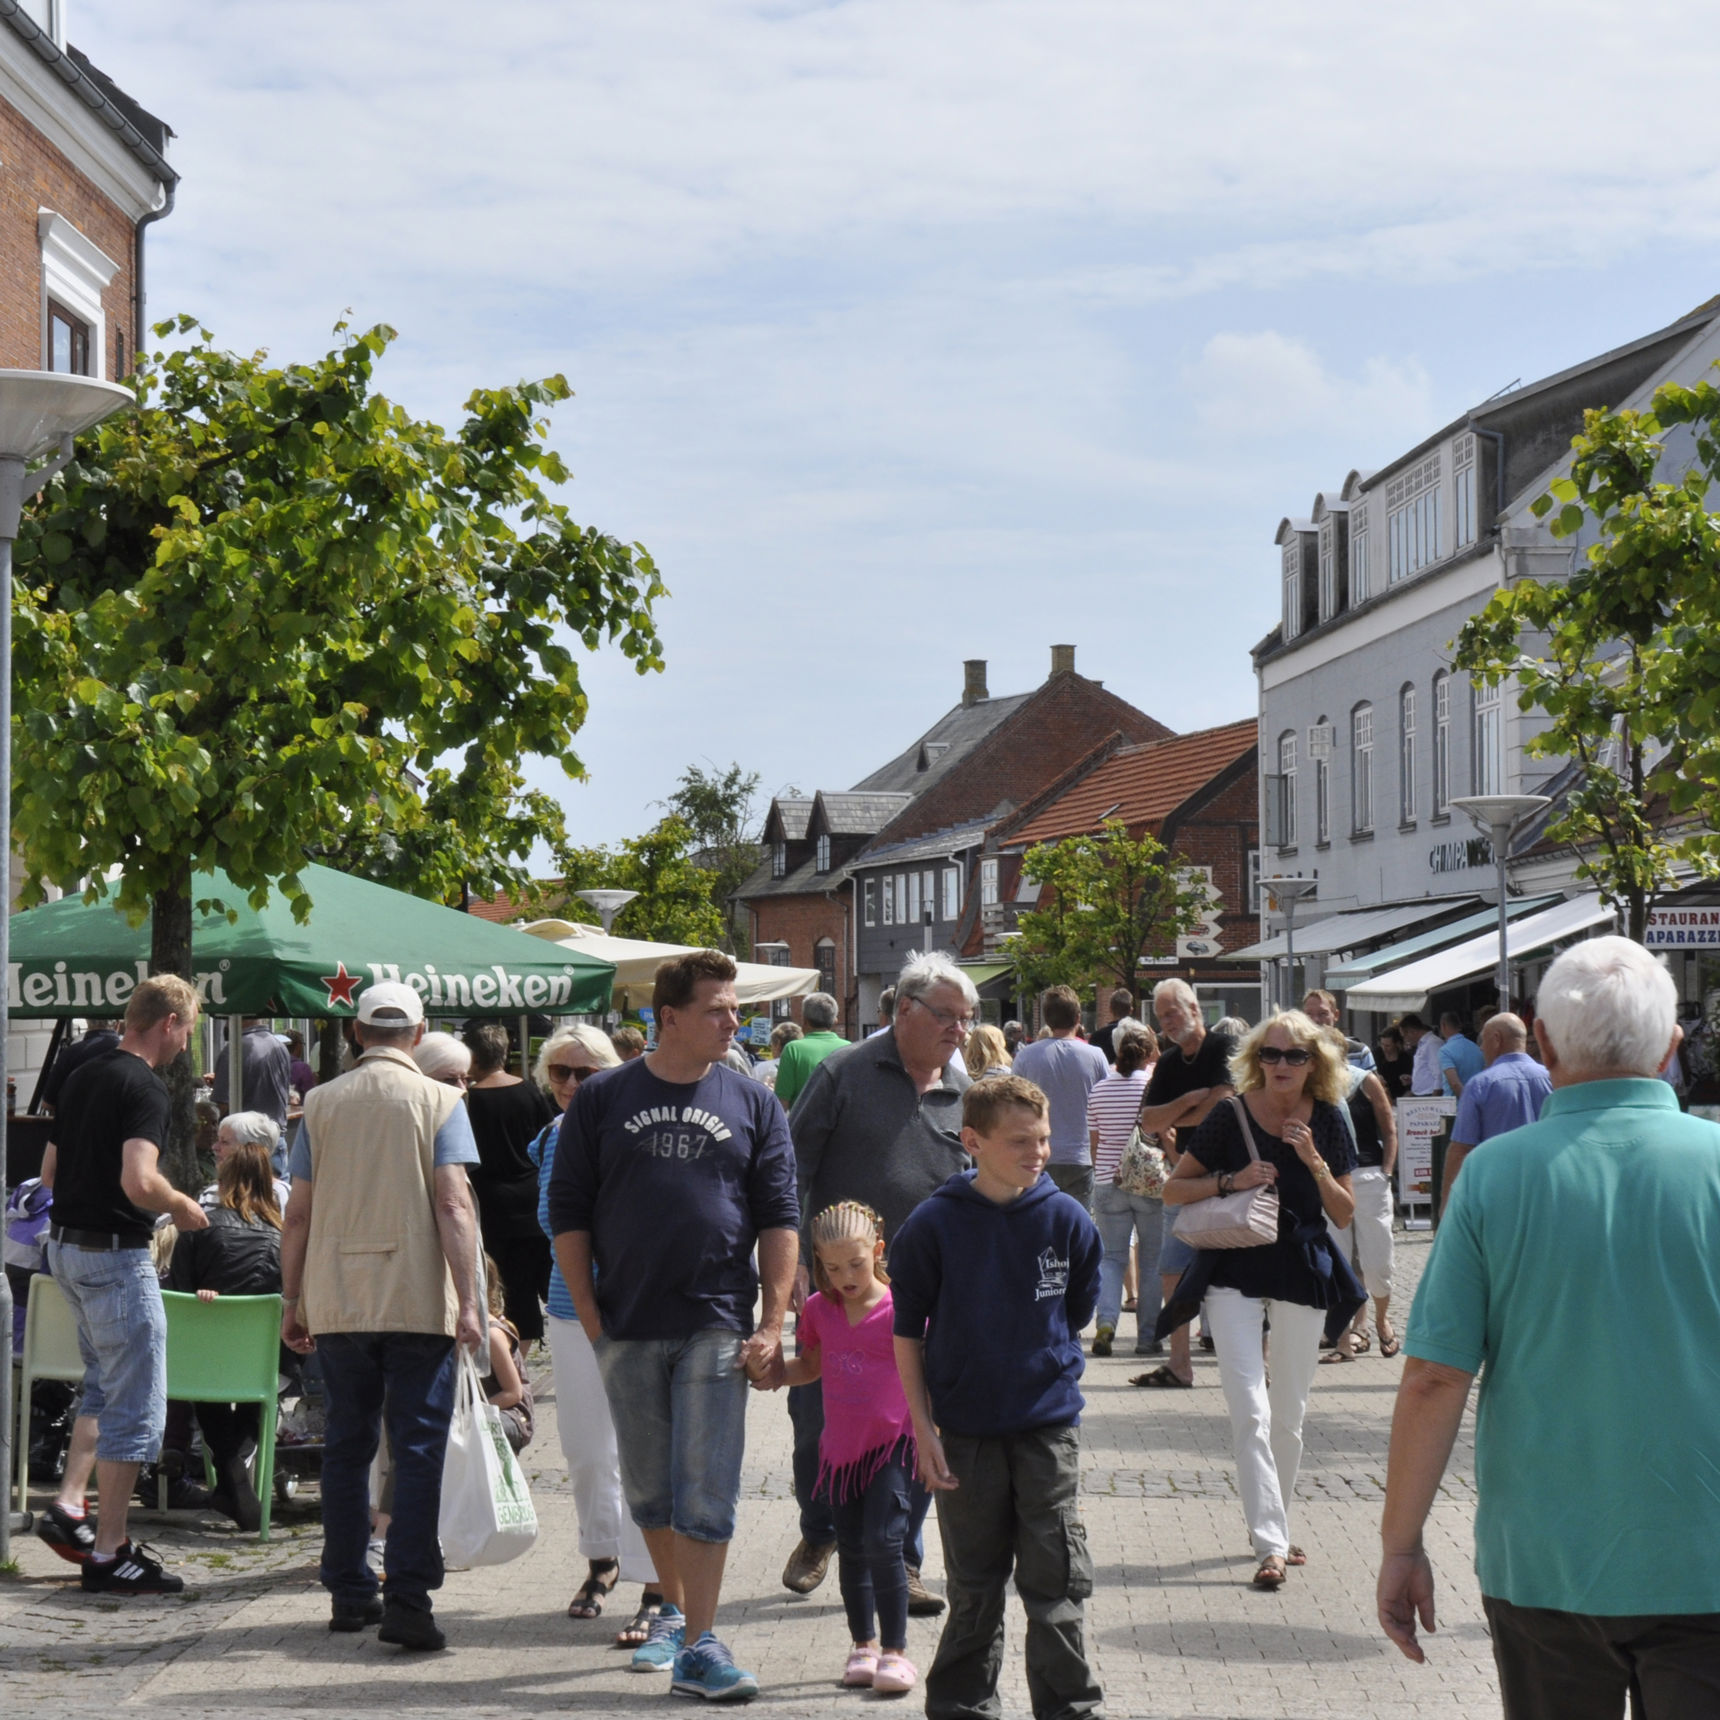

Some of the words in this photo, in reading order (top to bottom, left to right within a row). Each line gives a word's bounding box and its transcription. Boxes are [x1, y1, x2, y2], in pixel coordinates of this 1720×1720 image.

[1649, 912, 1720, 926] STAURAN
[1645, 930, 1720, 944] APARAZZ
[624, 1105, 678, 1134] SIGNAL
[651, 1132, 708, 1160] 1967
